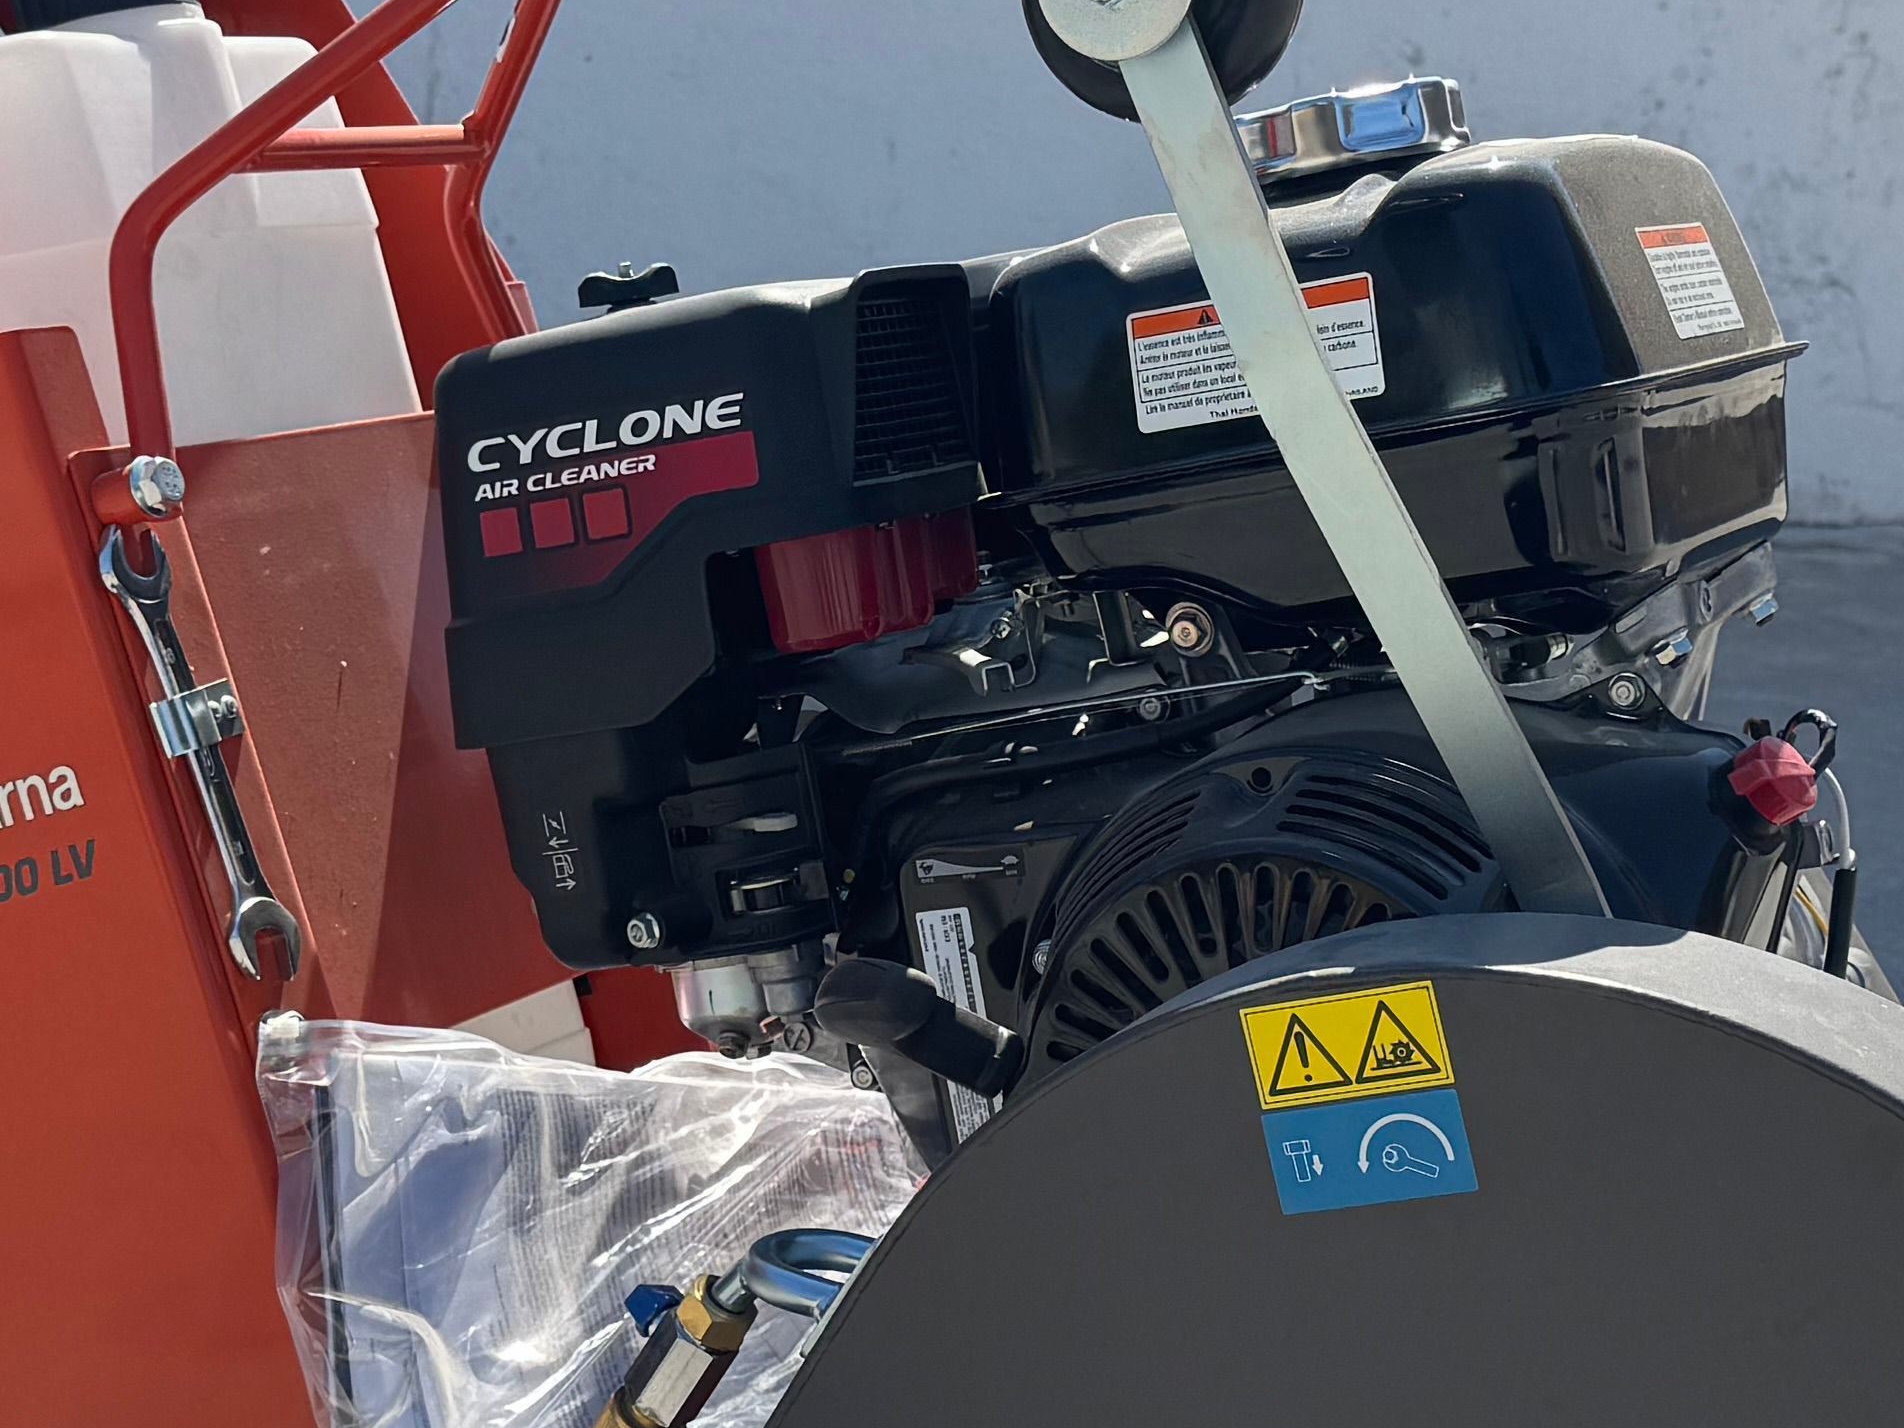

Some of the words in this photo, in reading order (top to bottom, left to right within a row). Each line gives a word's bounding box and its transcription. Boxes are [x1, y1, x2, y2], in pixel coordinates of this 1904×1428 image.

[467, 392, 744, 473] CYCLONE
[475, 479, 520, 502] AIR
[526, 454, 656, 492] CLEANER
[50, 839, 96, 886] LV
